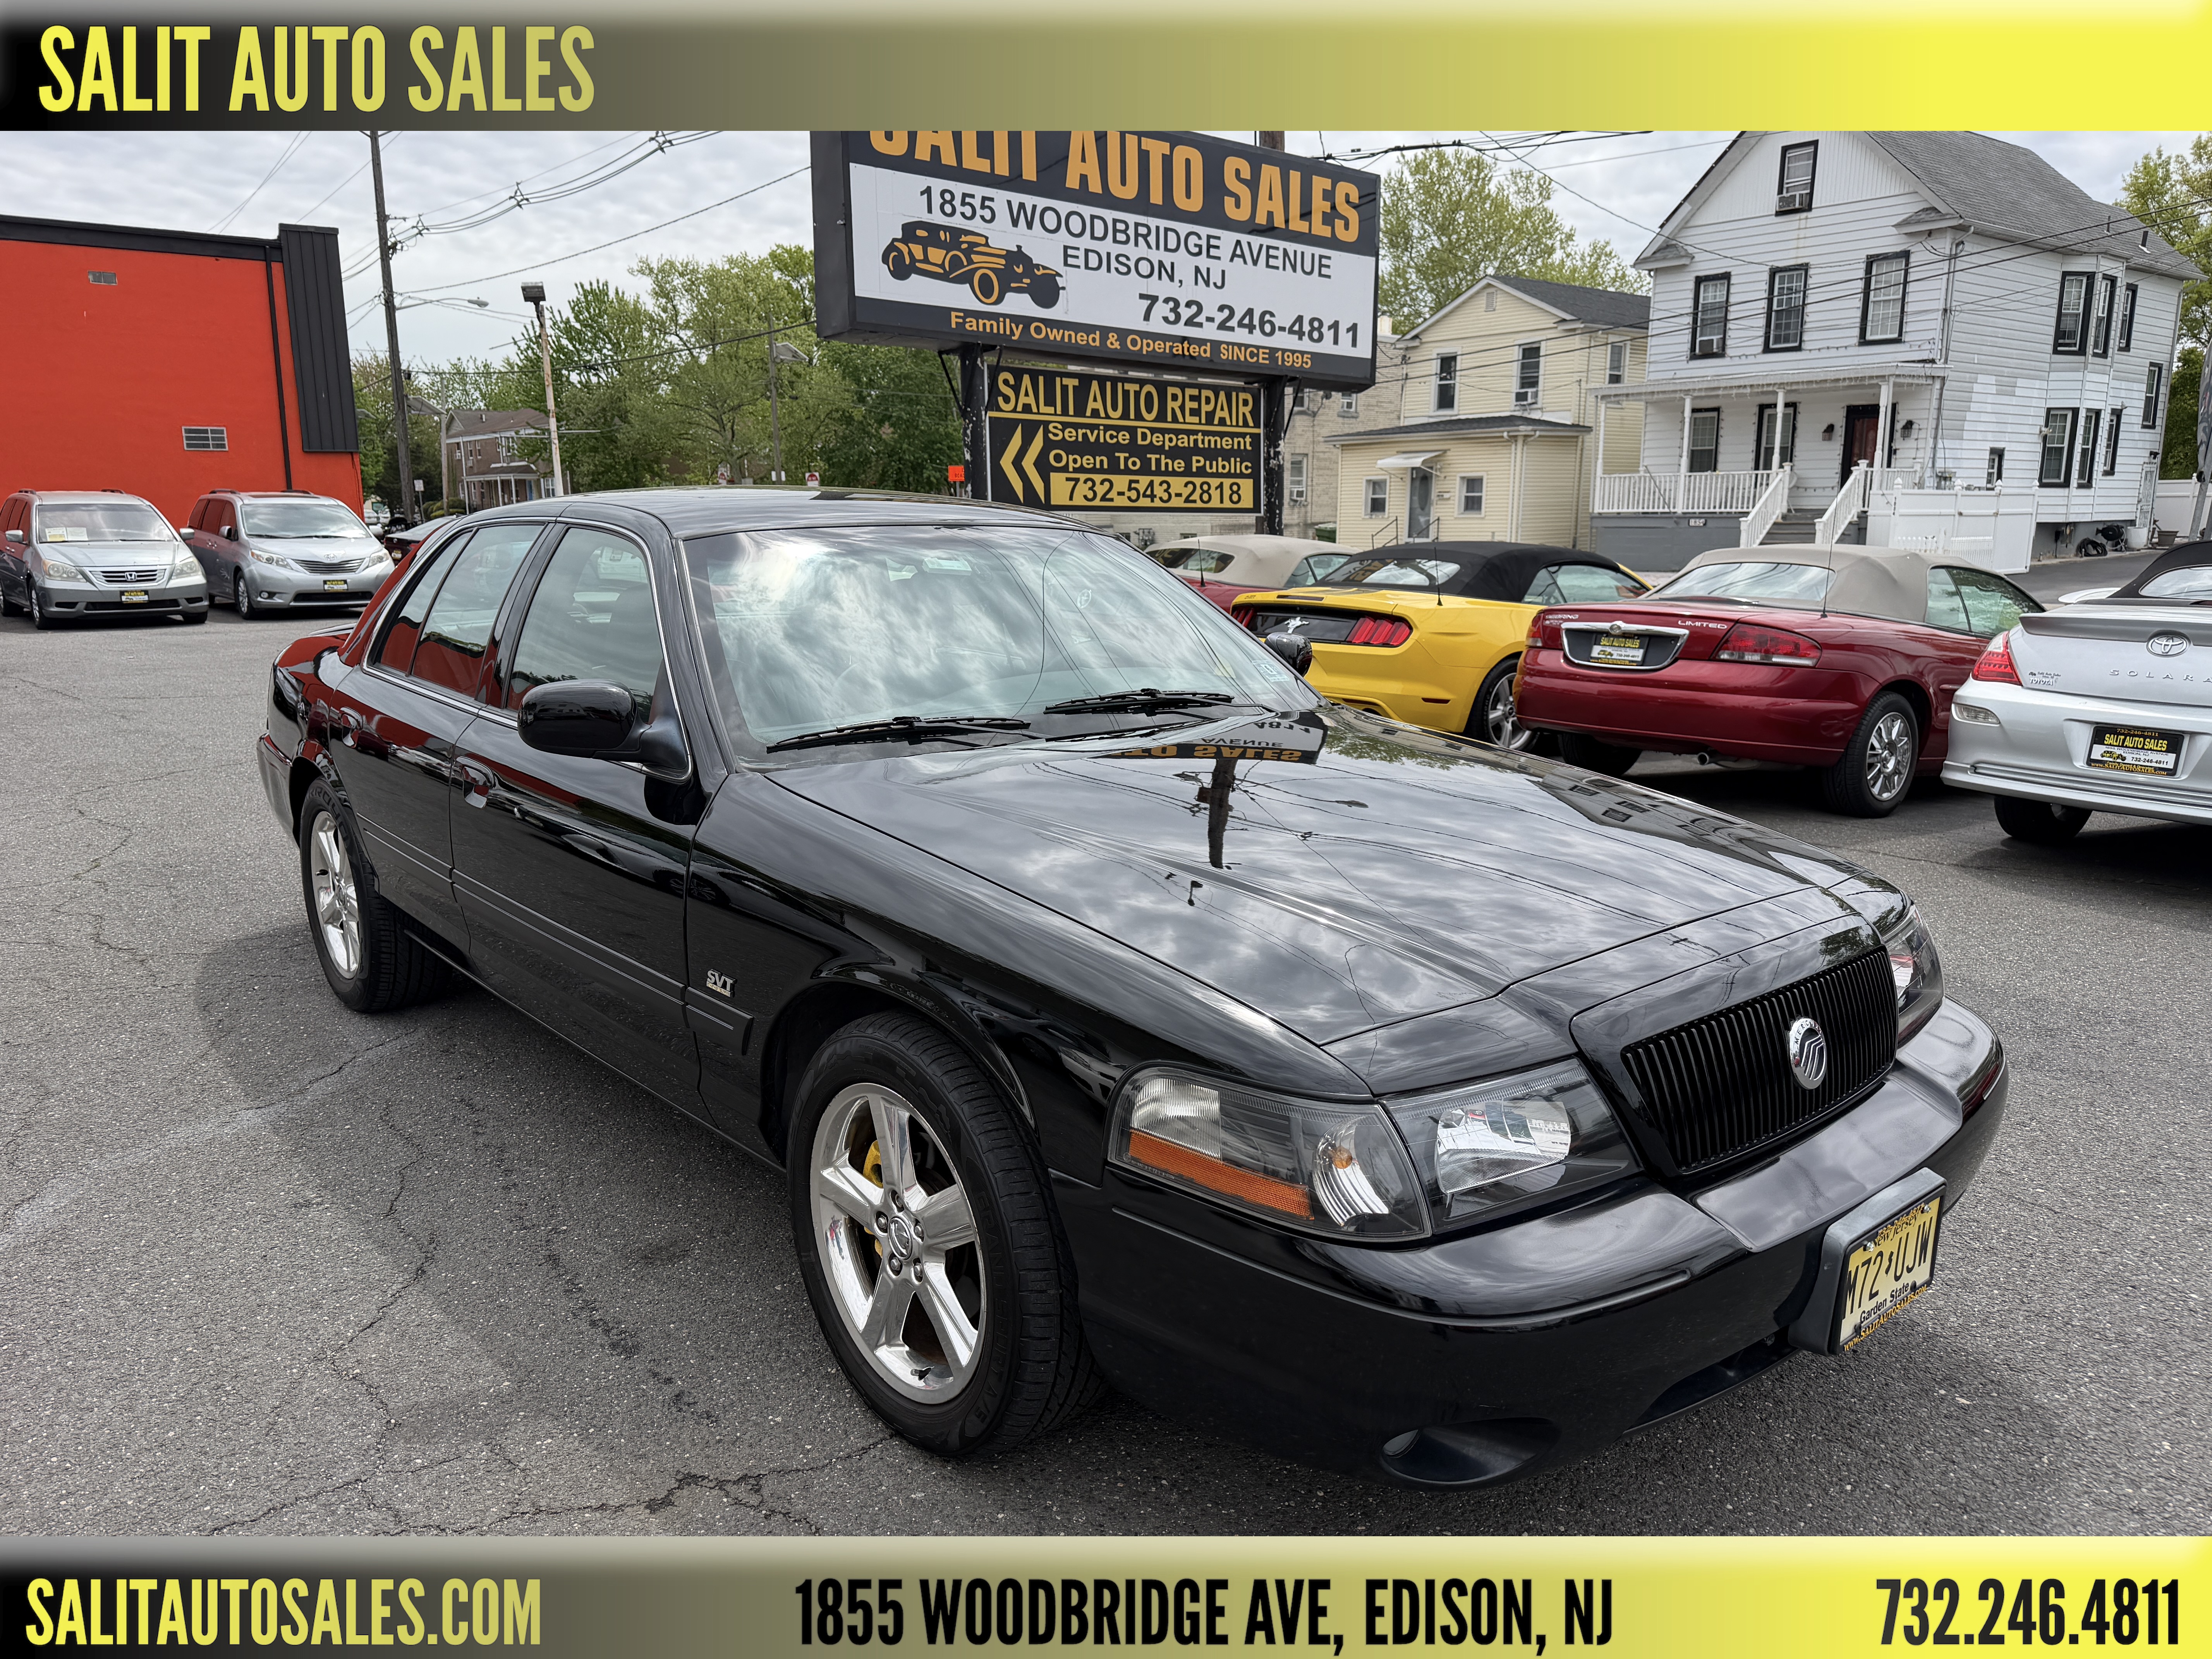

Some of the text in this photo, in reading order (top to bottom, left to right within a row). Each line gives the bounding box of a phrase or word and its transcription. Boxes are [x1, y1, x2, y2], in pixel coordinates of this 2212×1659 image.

[1066, 131, 1203, 212] AUTO
[1224, 156, 1359, 242] SALES
[920, 185, 1332, 279] 1855 WOODBRIDGE AVENUE
[1063, 245, 1226, 289] EDISON, NJ
[1139, 293, 1358, 348] 732-246-4811
[951, 312, 1312, 369] Family Owned & Operated SINCE 1995
[998, 371, 1254, 427] SALIT AUTO REPAIR
[1048, 422, 1252, 450] Service Department
[1049, 449, 1252, 474] Open To The Public
[1065, 477, 1242, 505] 732-543-2818
[1678, 620, 1728, 629] LIMITED
[1625, 639, 1640, 648] SALES
[2030, 678, 2053, 686] TOYOTA
[2104, 734, 2167, 751] SALIT AUTO SALES
[2116, 728, 2159, 737] 732-246-4811
[2131, 757, 2168, 766] 732-246-4811
[707, 969, 735, 991] SVT
[1860, 1282, 1909, 1324] Garden State
